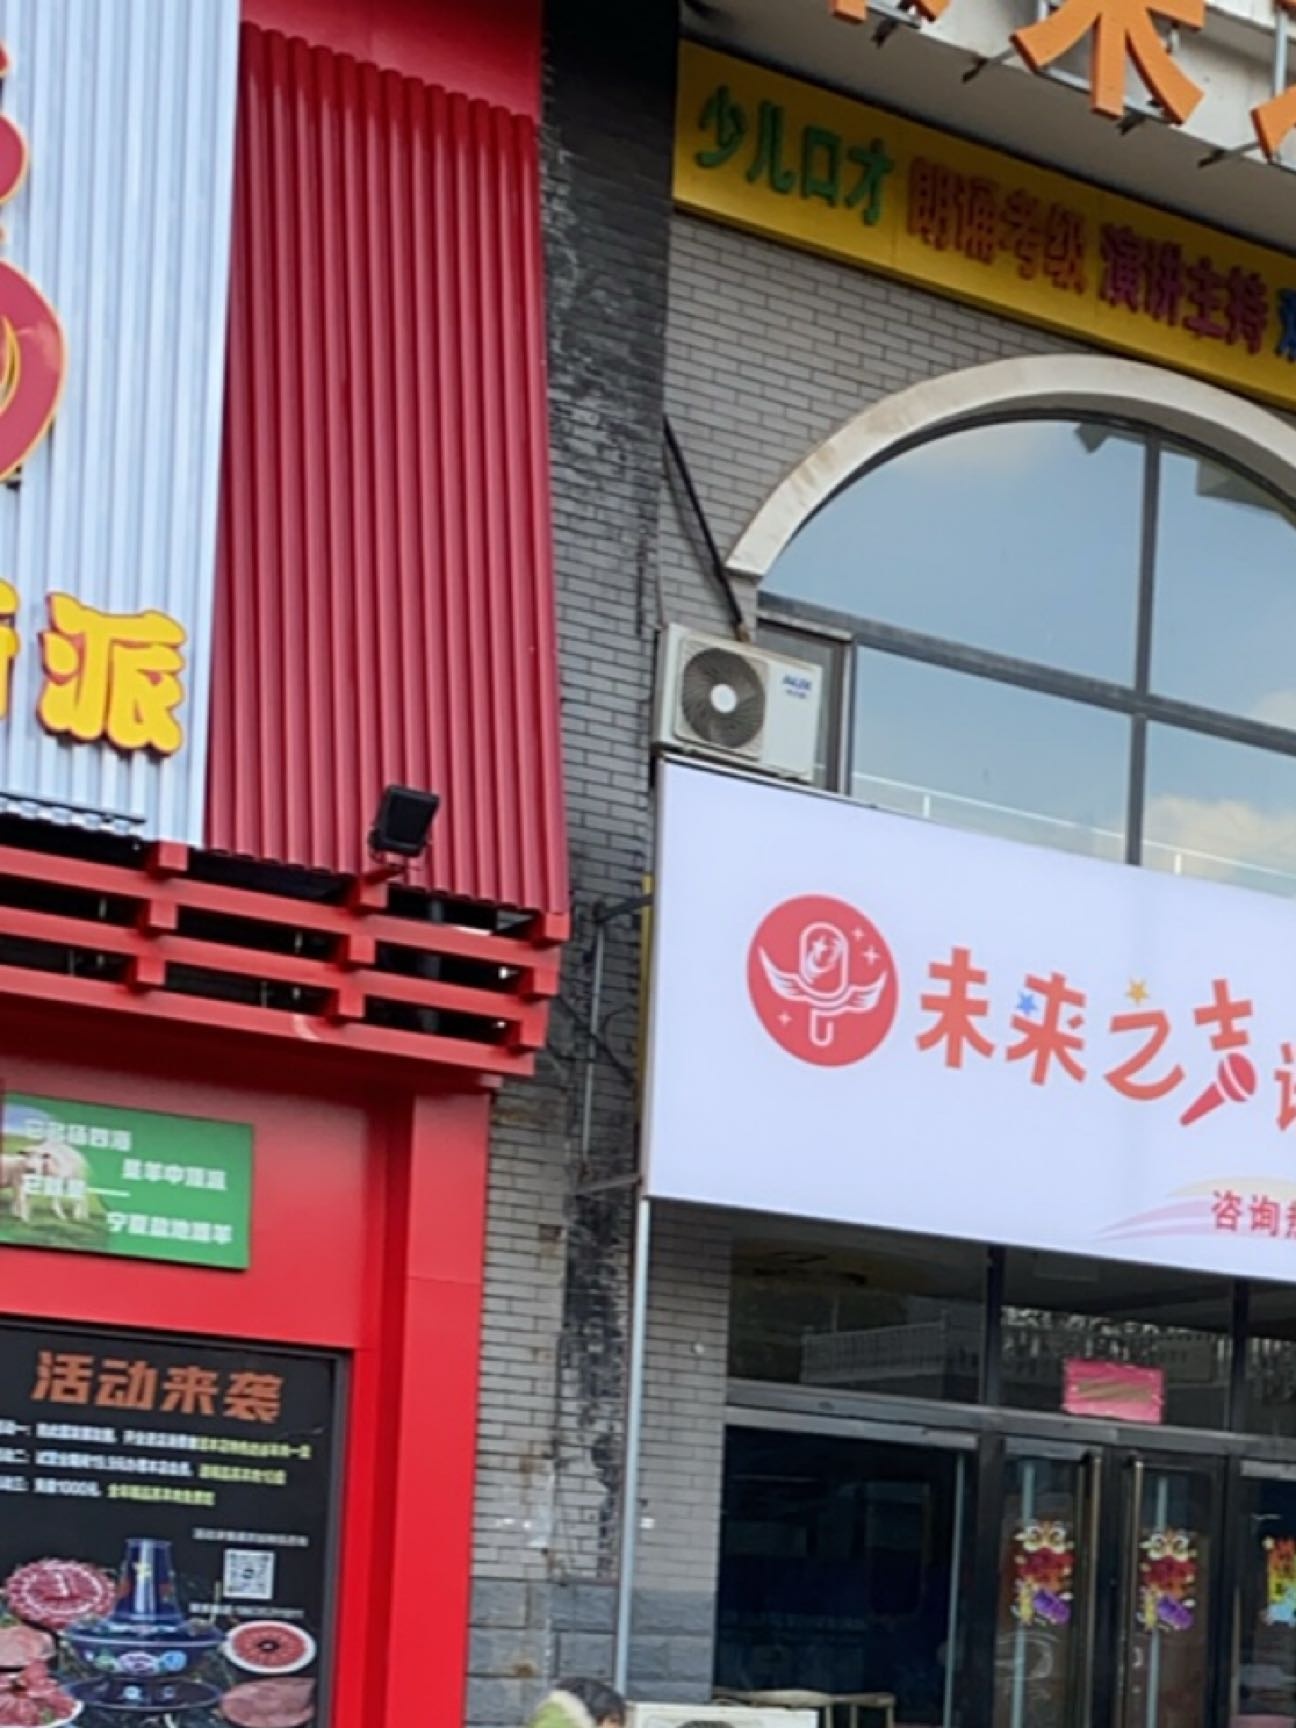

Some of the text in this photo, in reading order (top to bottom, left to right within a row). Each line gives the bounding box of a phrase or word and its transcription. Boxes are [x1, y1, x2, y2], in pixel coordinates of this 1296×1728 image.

[694, 84, 894, 226] 少儿口才
[1099, 222, 1269, 355] 演讲主持
[0, 578, 187, 758] 派
[30, 1349, 284, 1424] 活动来袭
